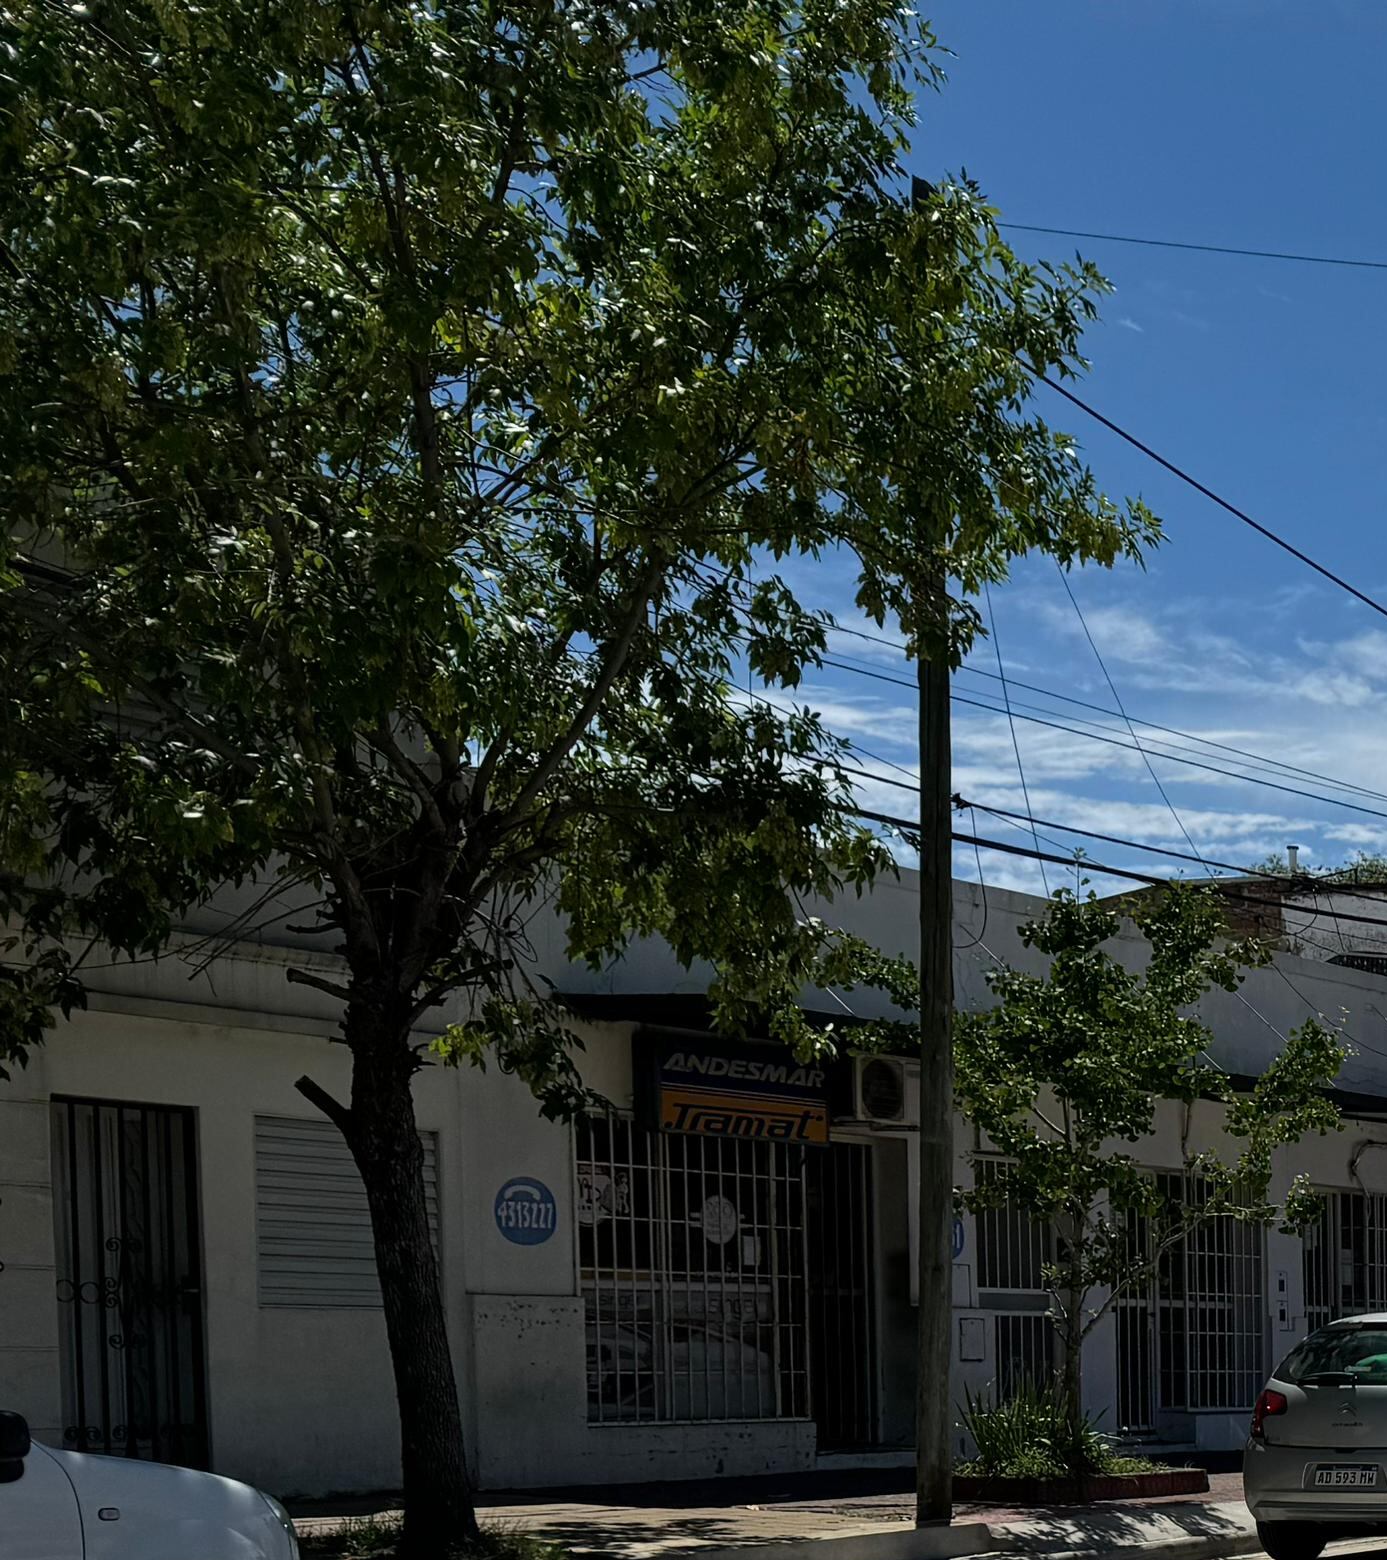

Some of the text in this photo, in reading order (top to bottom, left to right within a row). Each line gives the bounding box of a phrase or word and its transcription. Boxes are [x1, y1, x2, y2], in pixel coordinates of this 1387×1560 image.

[662, 1052, 825, 1088] ANDESMAR
[496, 1200, 555, 1231] 4313227
[1317, 1472, 1332, 1484] AD
[1335, 1472, 1357, 1484] 593
